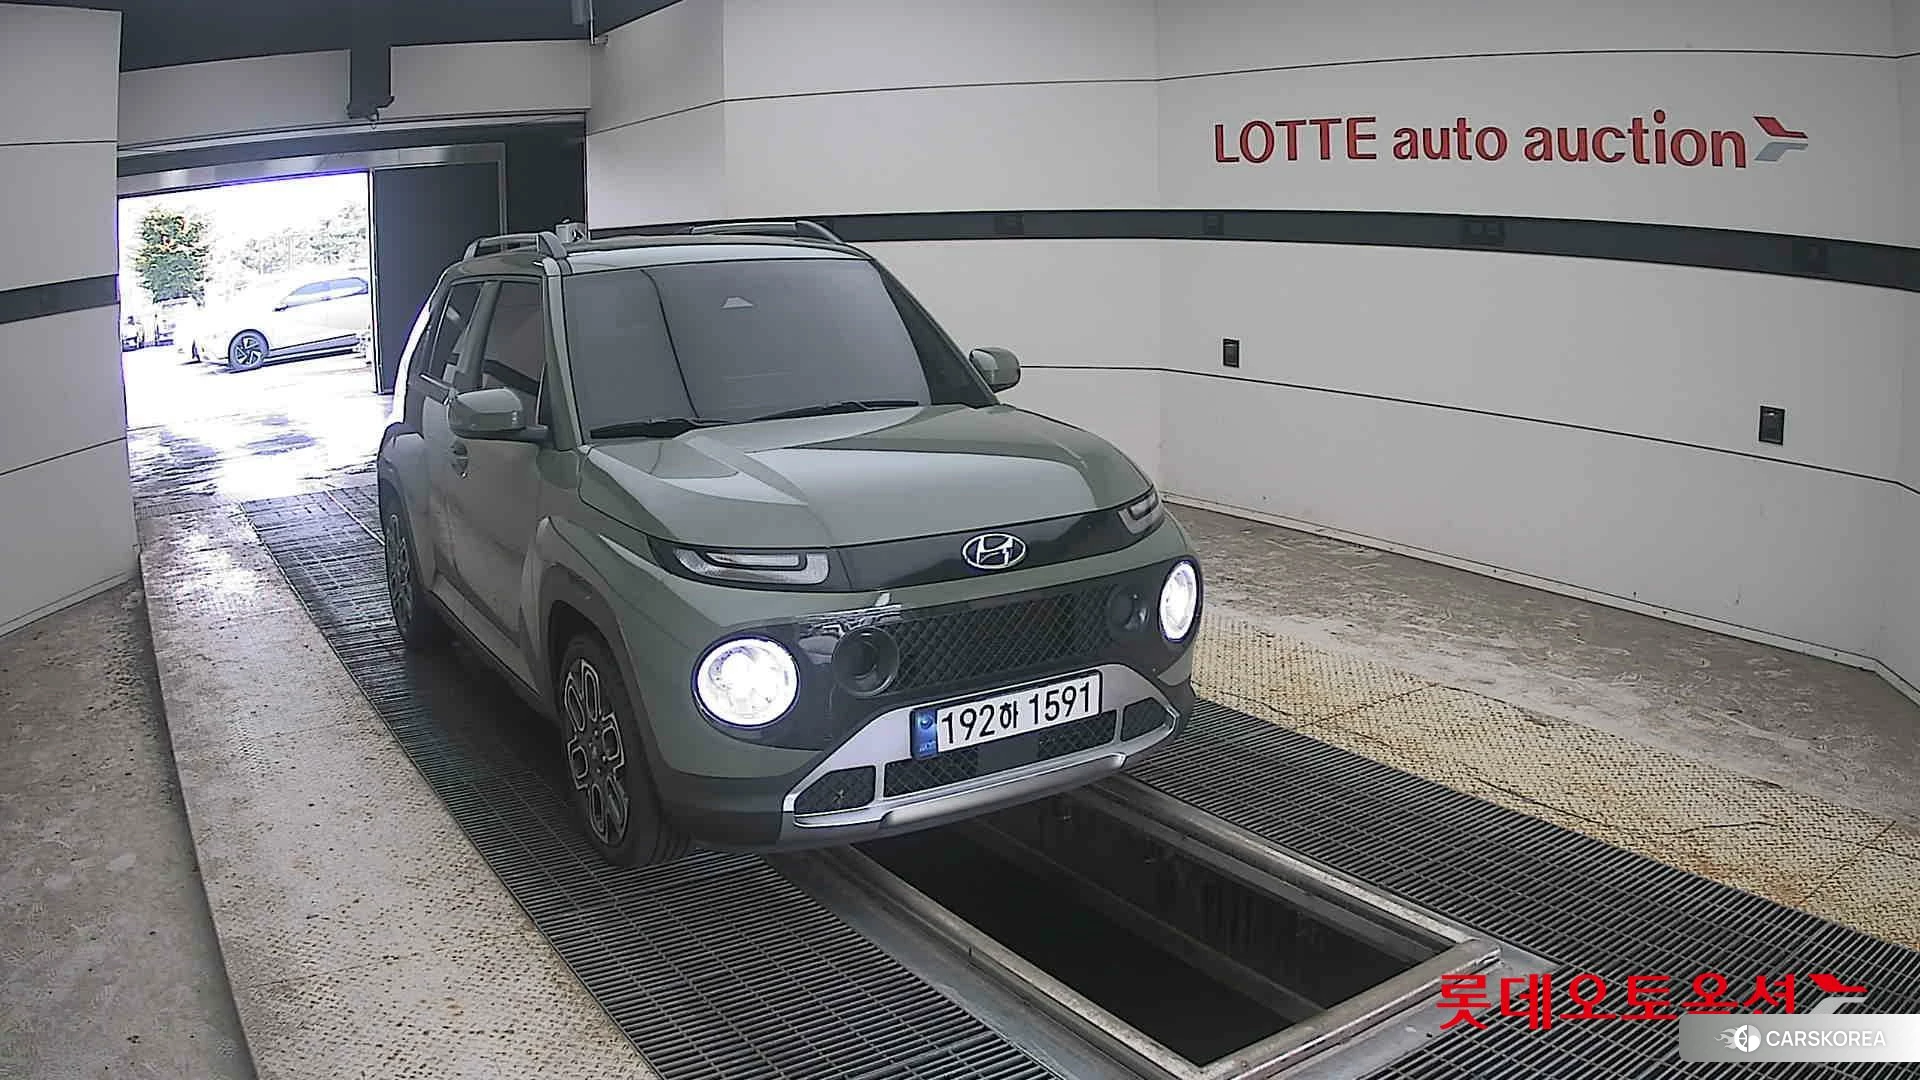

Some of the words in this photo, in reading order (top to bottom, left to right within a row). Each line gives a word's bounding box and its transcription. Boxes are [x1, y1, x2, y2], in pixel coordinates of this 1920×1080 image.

[1214, 116, 1377, 164] LOTTE
[1392, 117, 1508, 161] auto
[1523, 109, 1747, 168] auction
[941, 700, 1019, 744] 192하
[1029, 681, 1090, 725] 1591
